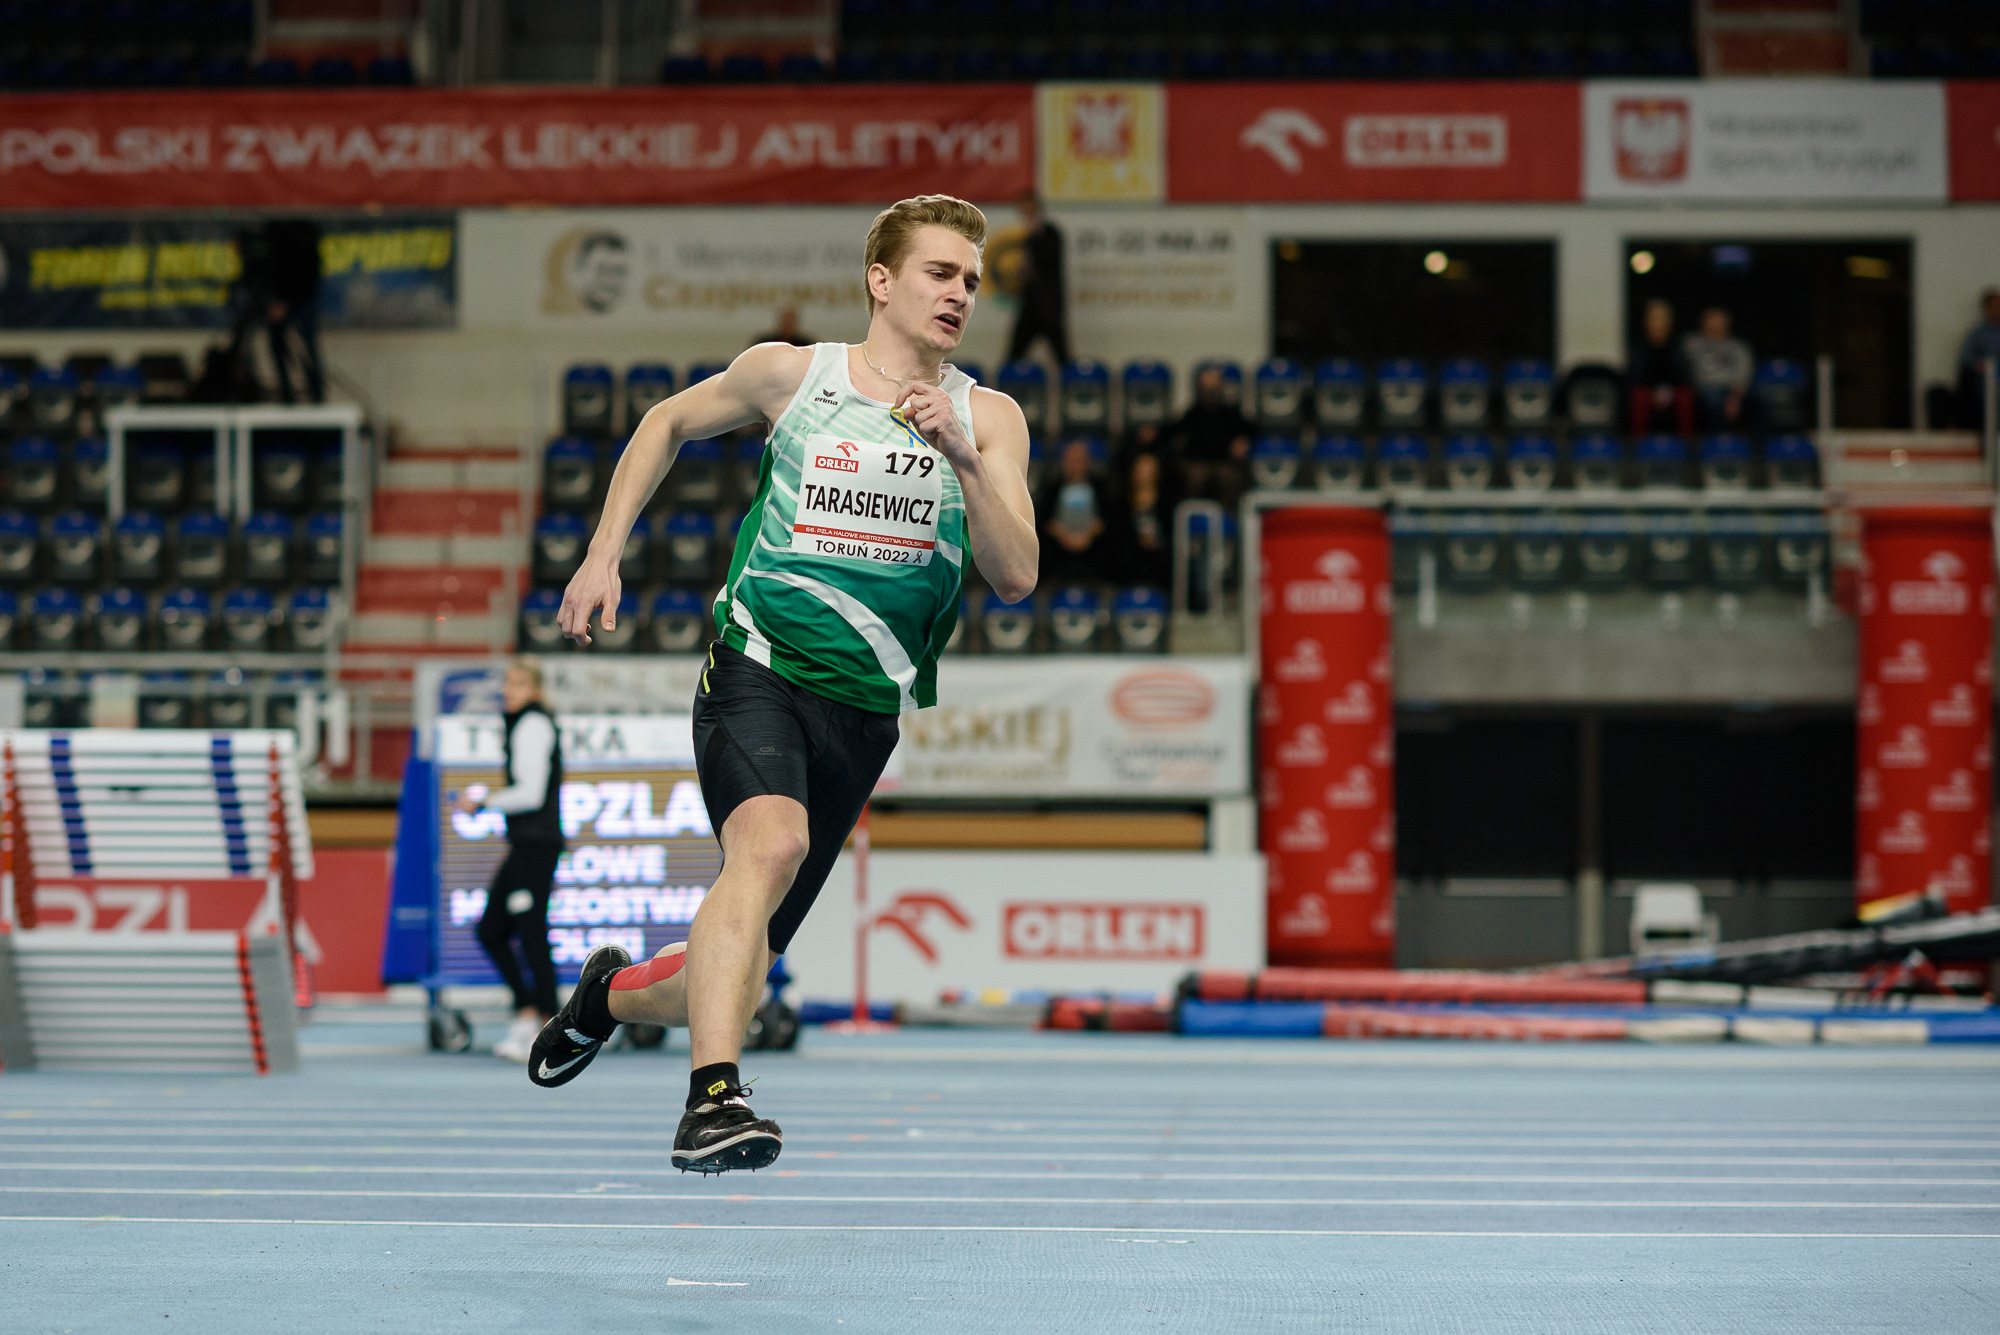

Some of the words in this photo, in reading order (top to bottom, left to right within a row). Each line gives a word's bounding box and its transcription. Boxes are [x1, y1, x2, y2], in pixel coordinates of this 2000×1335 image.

[2, 126, 211, 174] POLSKI
[503, 121, 739, 169] LEKKIEJ
[751, 119, 1018, 165] ATLETYKI
[1356, 123, 1497, 158] ORLEN
[814, 396, 838, 406] erima
[816, 456, 858, 473] ORLEN
[885, 451, 935, 478] 179
[804, 483, 935, 526] TARASIEWICZ
[816, 528, 833, 536] PZLA
[833, 530, 859, 540] HALOWE
[858, 533, 902, 545] MISTRZOSTWA
[902, 539, 924, 548] POLSKI
[816, 540, 868, 558] TORUŃ
[872, 547, 910, 563] 2022
[464, 725, 626, 753] TKA
[559, 781, 712, 838] PZLA
[554, 845, 668, 884] LOWE
[1010, 909, 1197, 953] ORLEN
[564, 1028, 597, 1046] NIKE
[710, 1081, 724, 1093] NIKE
